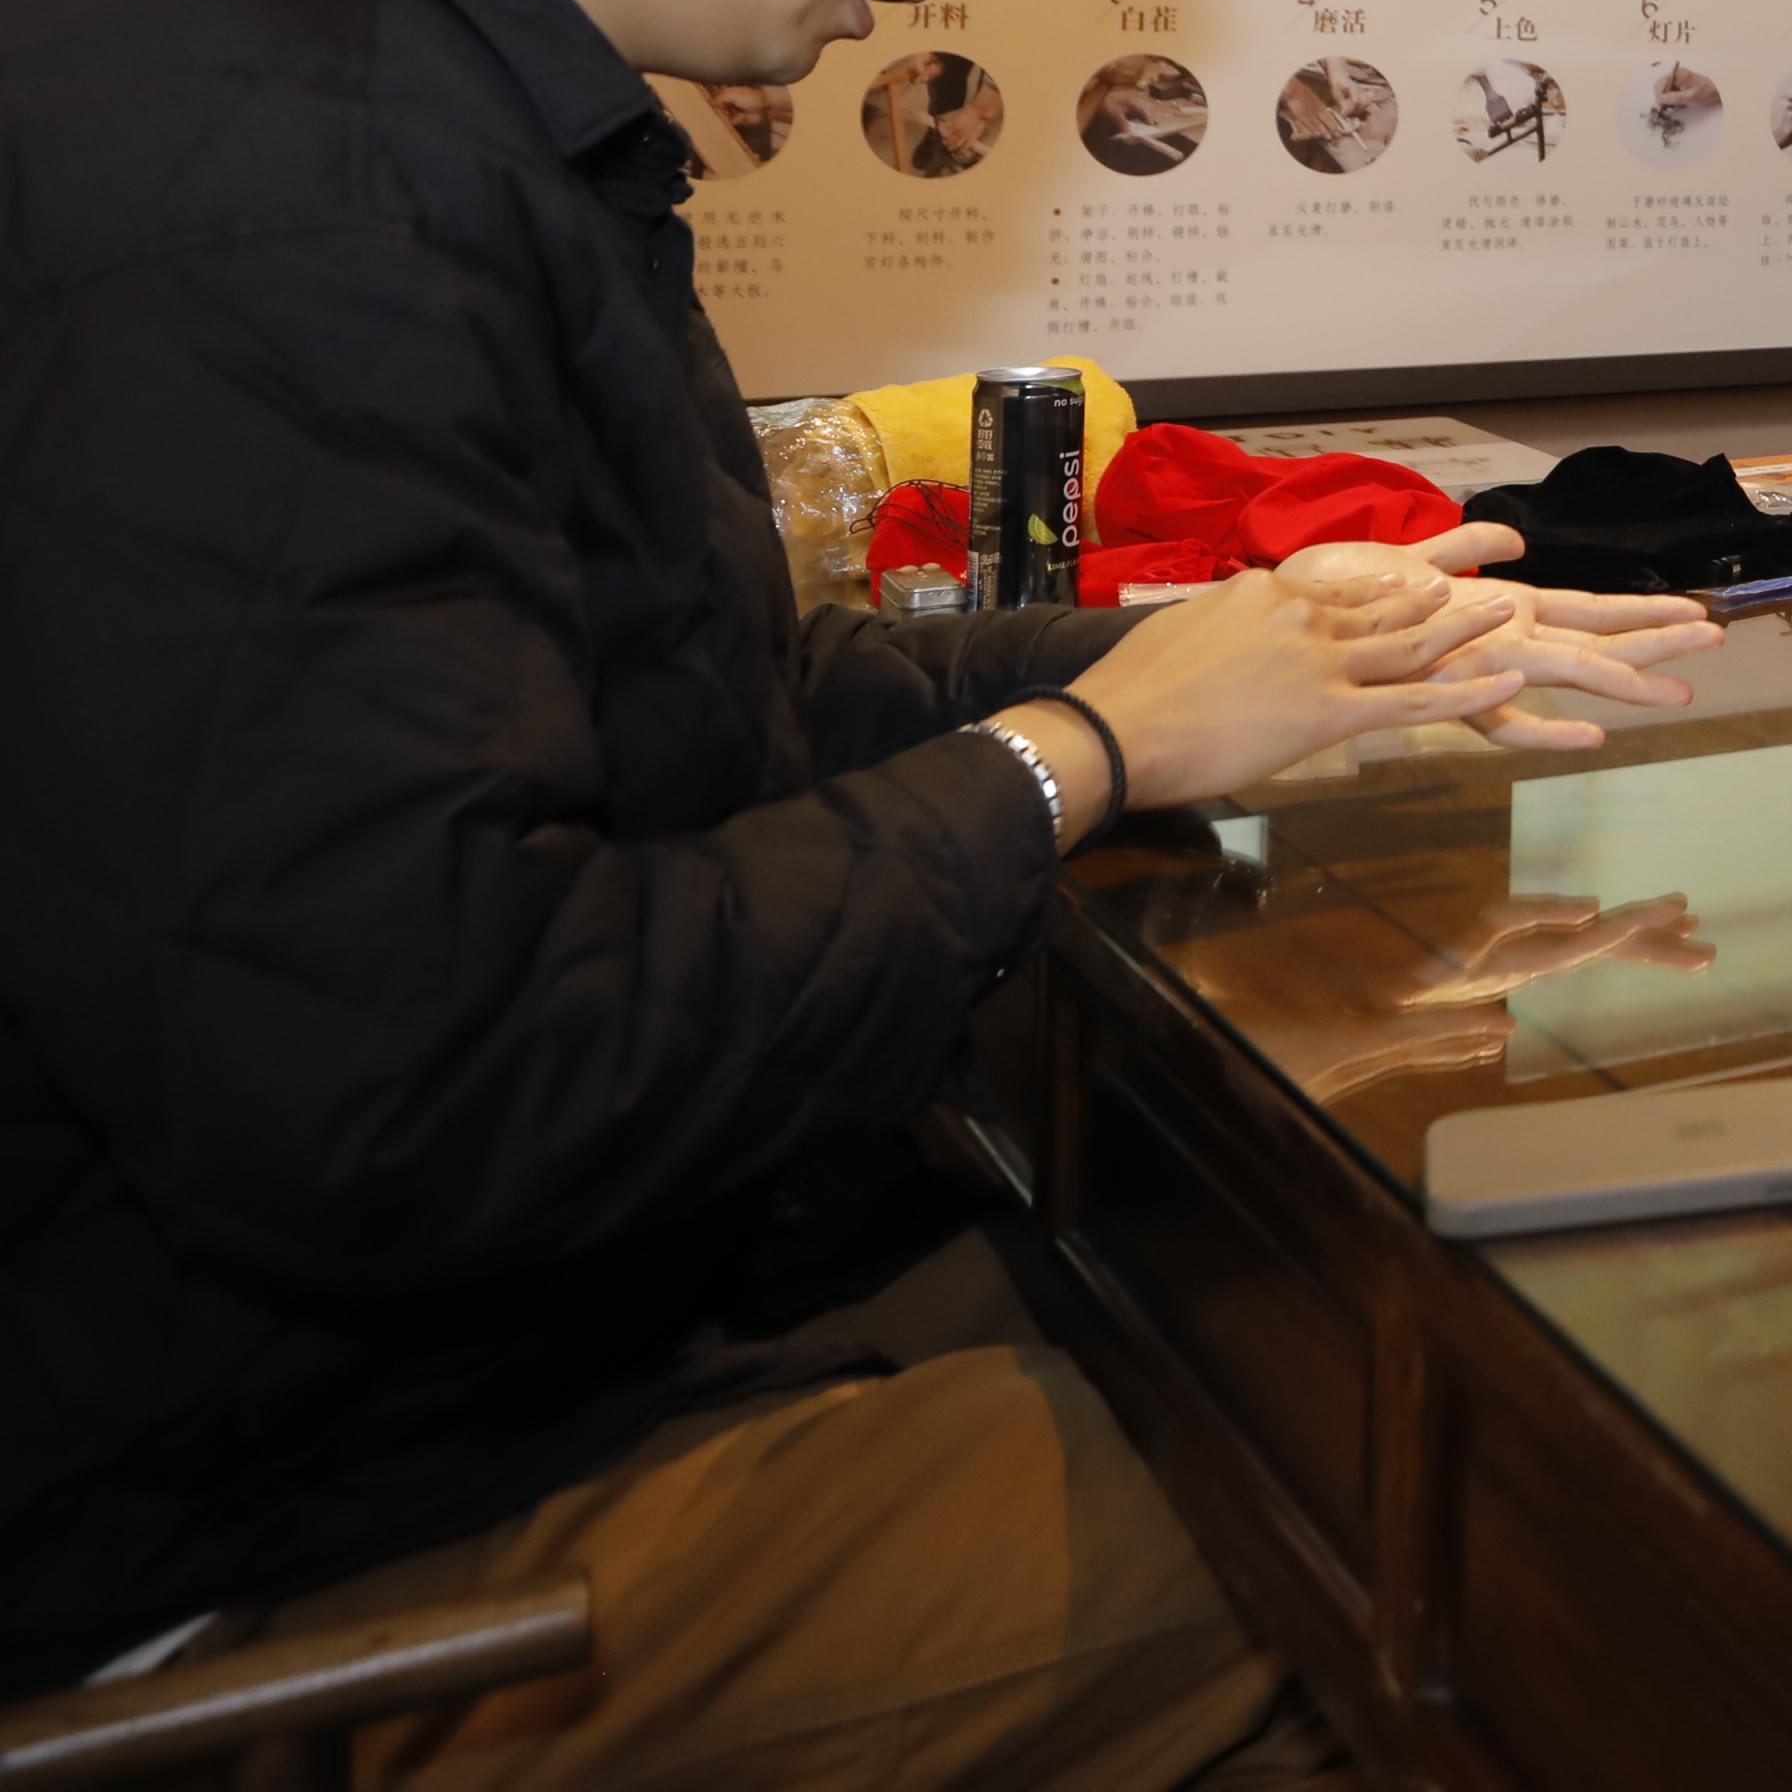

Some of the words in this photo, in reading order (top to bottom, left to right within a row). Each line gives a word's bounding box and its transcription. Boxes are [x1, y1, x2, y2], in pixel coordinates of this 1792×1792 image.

[907, 3, 970, 30] 开料
[1311, 7, 1367, 35] 磨活
[1491, 16, 1539, 43] 上色
[1649, 20, 1697, 46] 灯片
[1053, 398, 1068, 407] no
[1059, 450, 1080, 547] pepsi
